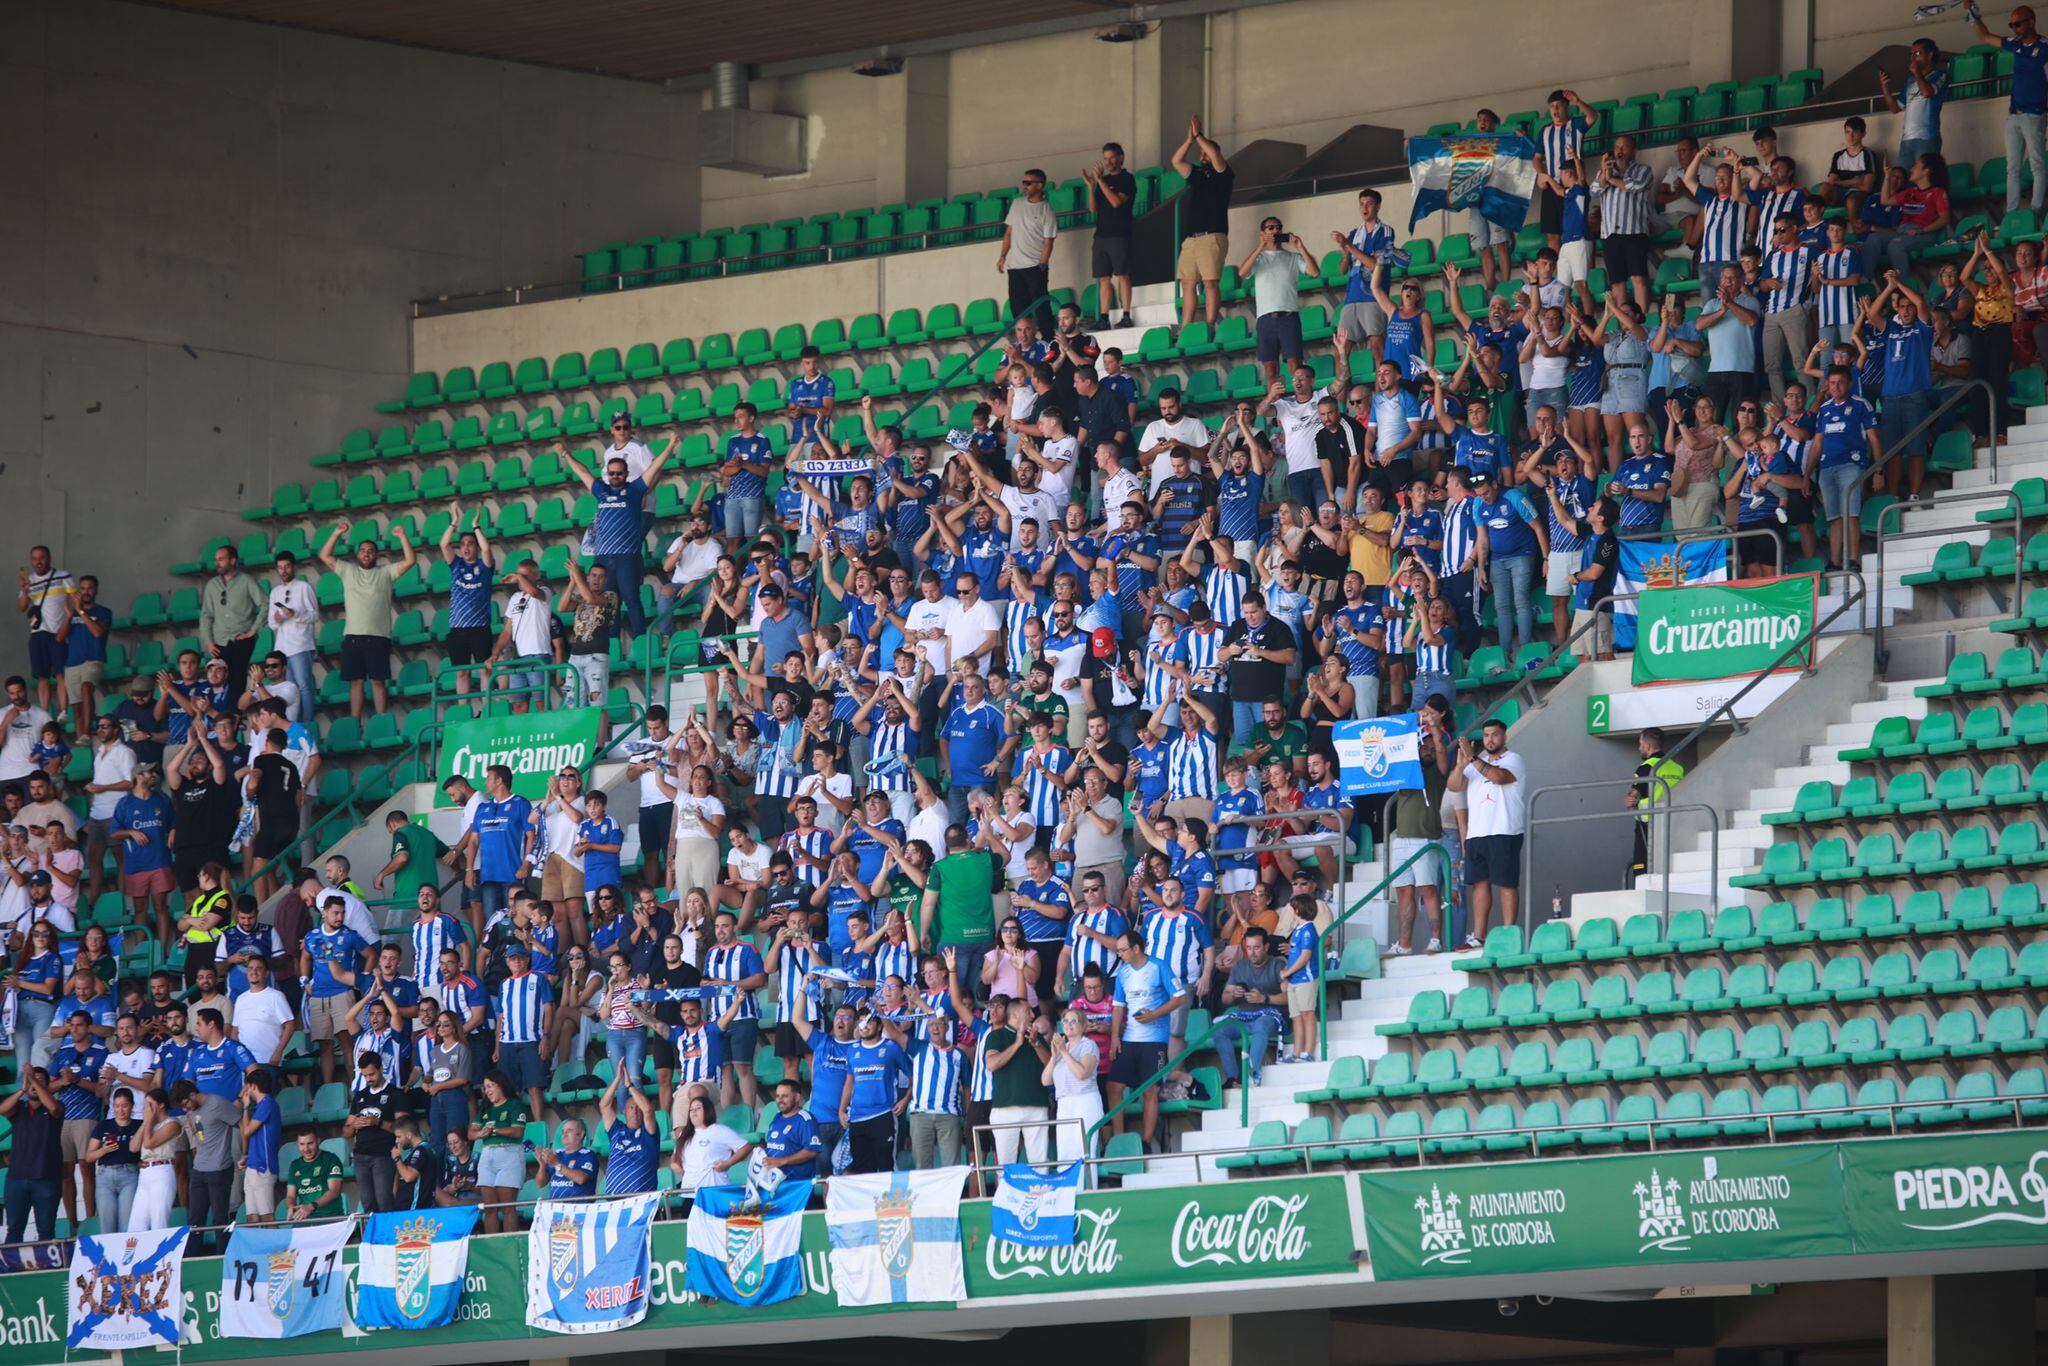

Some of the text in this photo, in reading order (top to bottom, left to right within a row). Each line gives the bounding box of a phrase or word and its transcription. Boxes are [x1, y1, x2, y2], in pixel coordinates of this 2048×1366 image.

[807, 459, 868, 471] XEREZ CD
[1650, 613, 1801, 656] Cruzcampo
[1591, 701, 1606, 727] 2
[453, 742, 586, 780] Cruzcampo
[1469, 1189, 1566, 1218] AYUNTAMIENTO
[1689, 1175, 1791, 1205] AYUNTAMIENTO
[1171, 1194, 1309, 1268] Coca-Cola
[1471, 1221, 1556, 1248] DE CORDOBA
[1691, 1207, 1780, 1235] DE CORDOBA
[76, 1262, 173, 1321] XEREZ
[1680, 1286, 1696, 1296] Exit
